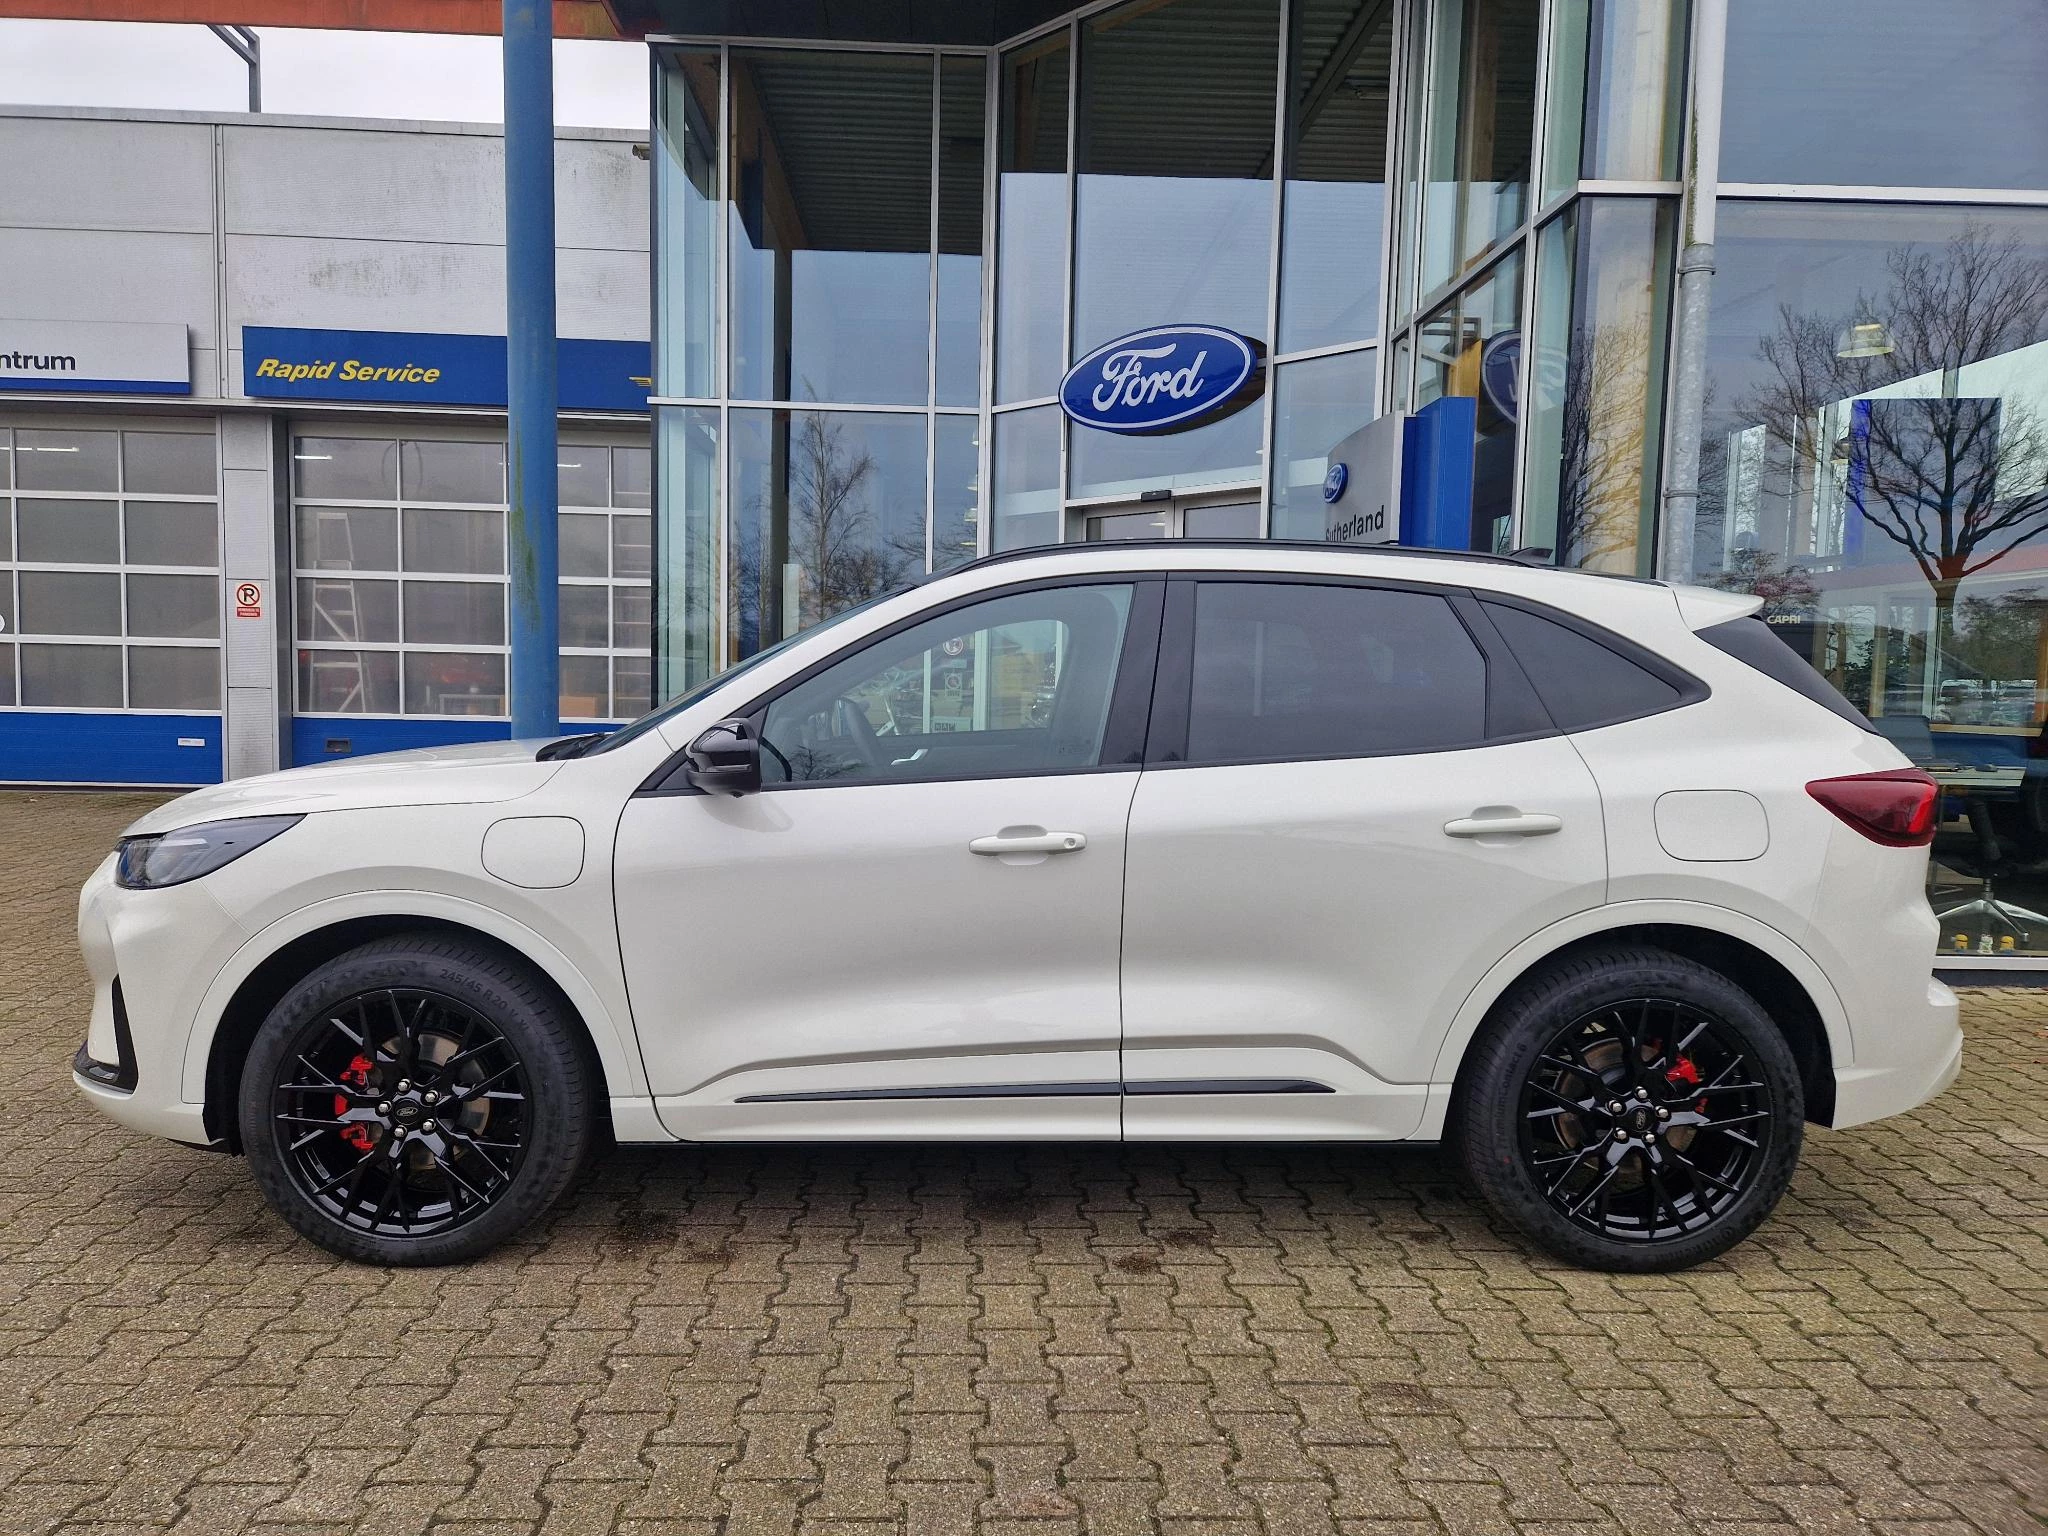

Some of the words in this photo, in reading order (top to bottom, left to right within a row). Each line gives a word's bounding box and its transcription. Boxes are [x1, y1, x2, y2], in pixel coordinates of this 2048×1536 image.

[0, 351, 76, 370] ntrum
[256, 358, 336, 382] Rapid
[338, 360, 440, 383] Service
[1092, 343, 1207, 412] Ford
[1325, 504, 1384, 542] Sutherland
[1766, 614, 1801, 624] CAPRI
[440, 968, 483, 993] 245/45
